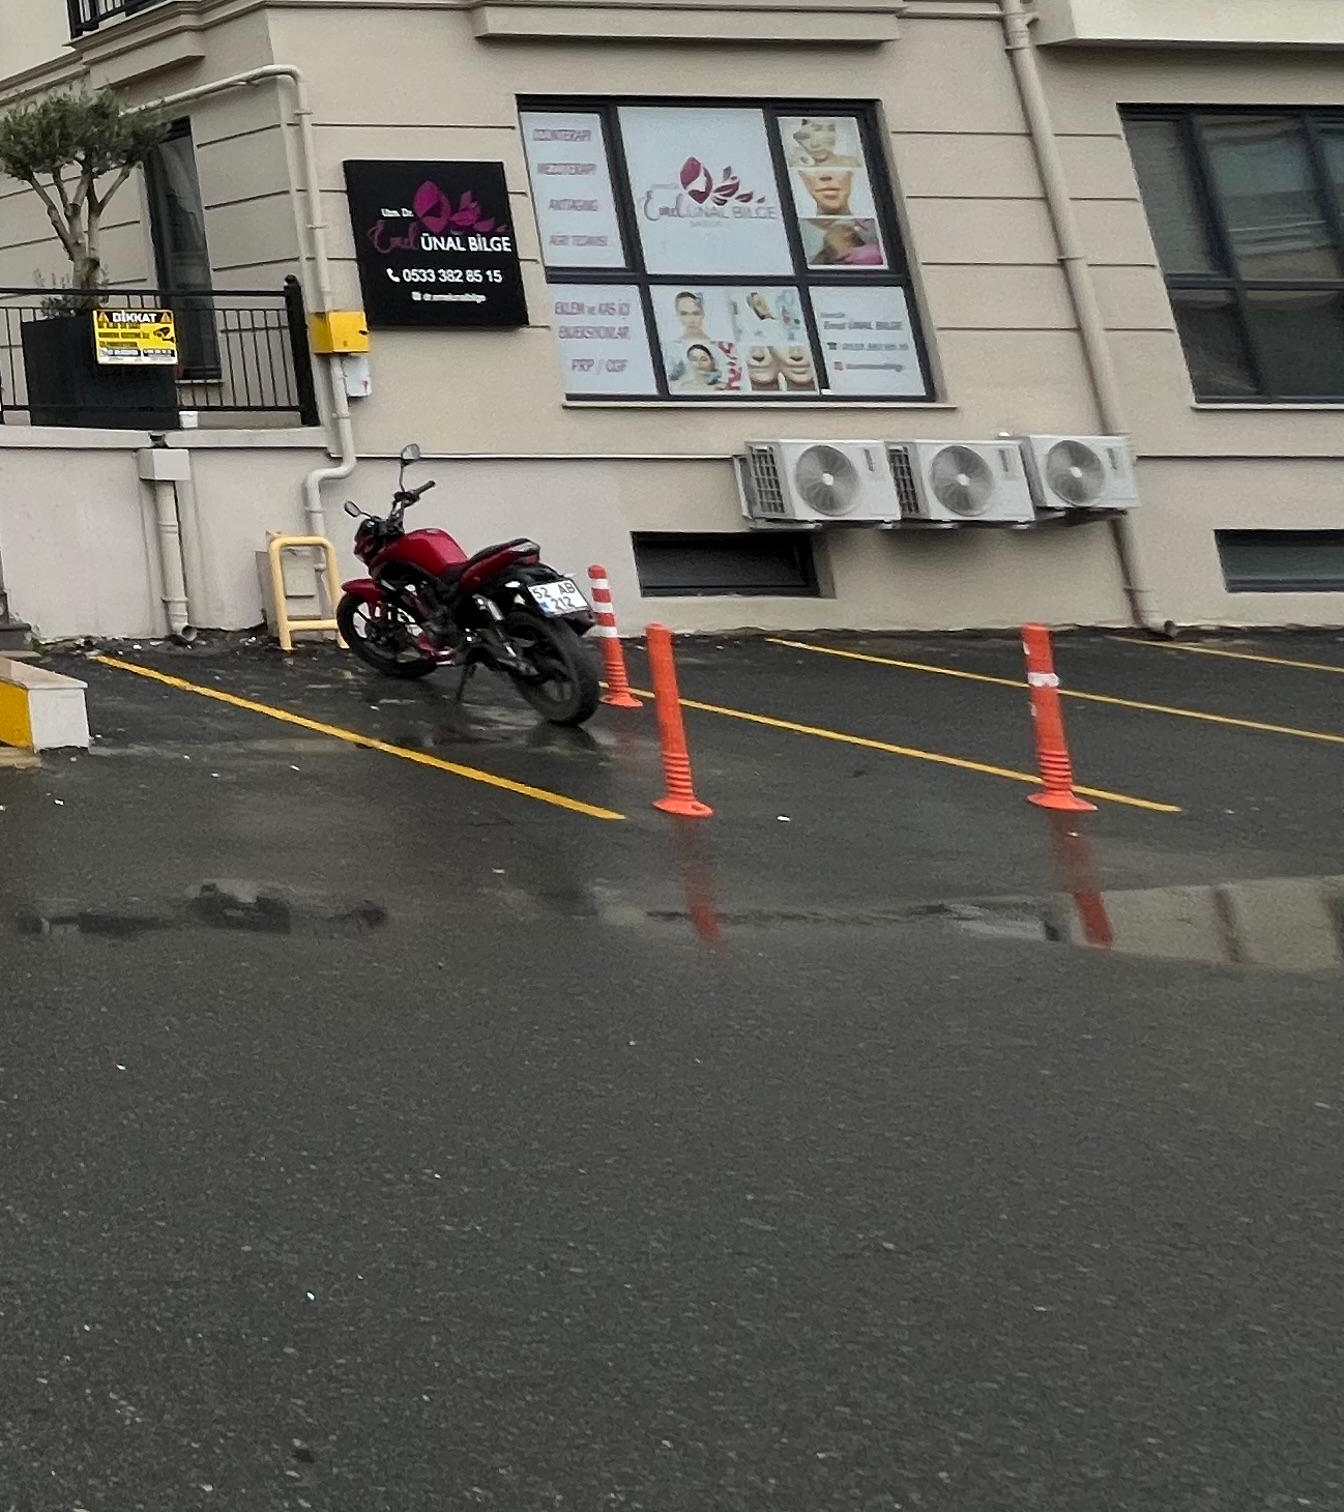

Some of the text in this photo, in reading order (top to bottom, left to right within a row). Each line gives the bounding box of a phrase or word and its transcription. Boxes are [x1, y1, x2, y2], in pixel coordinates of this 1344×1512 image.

[420, 233, 466, 252] ÜNAL
[468, 234, 512, 252] BİLGE
[402, 268, 436, 283] 0533
[438, 269, 463, 283] 382
[485, 270, 503, 283] 15
[112, 310, 157, 323] DİKKAT
